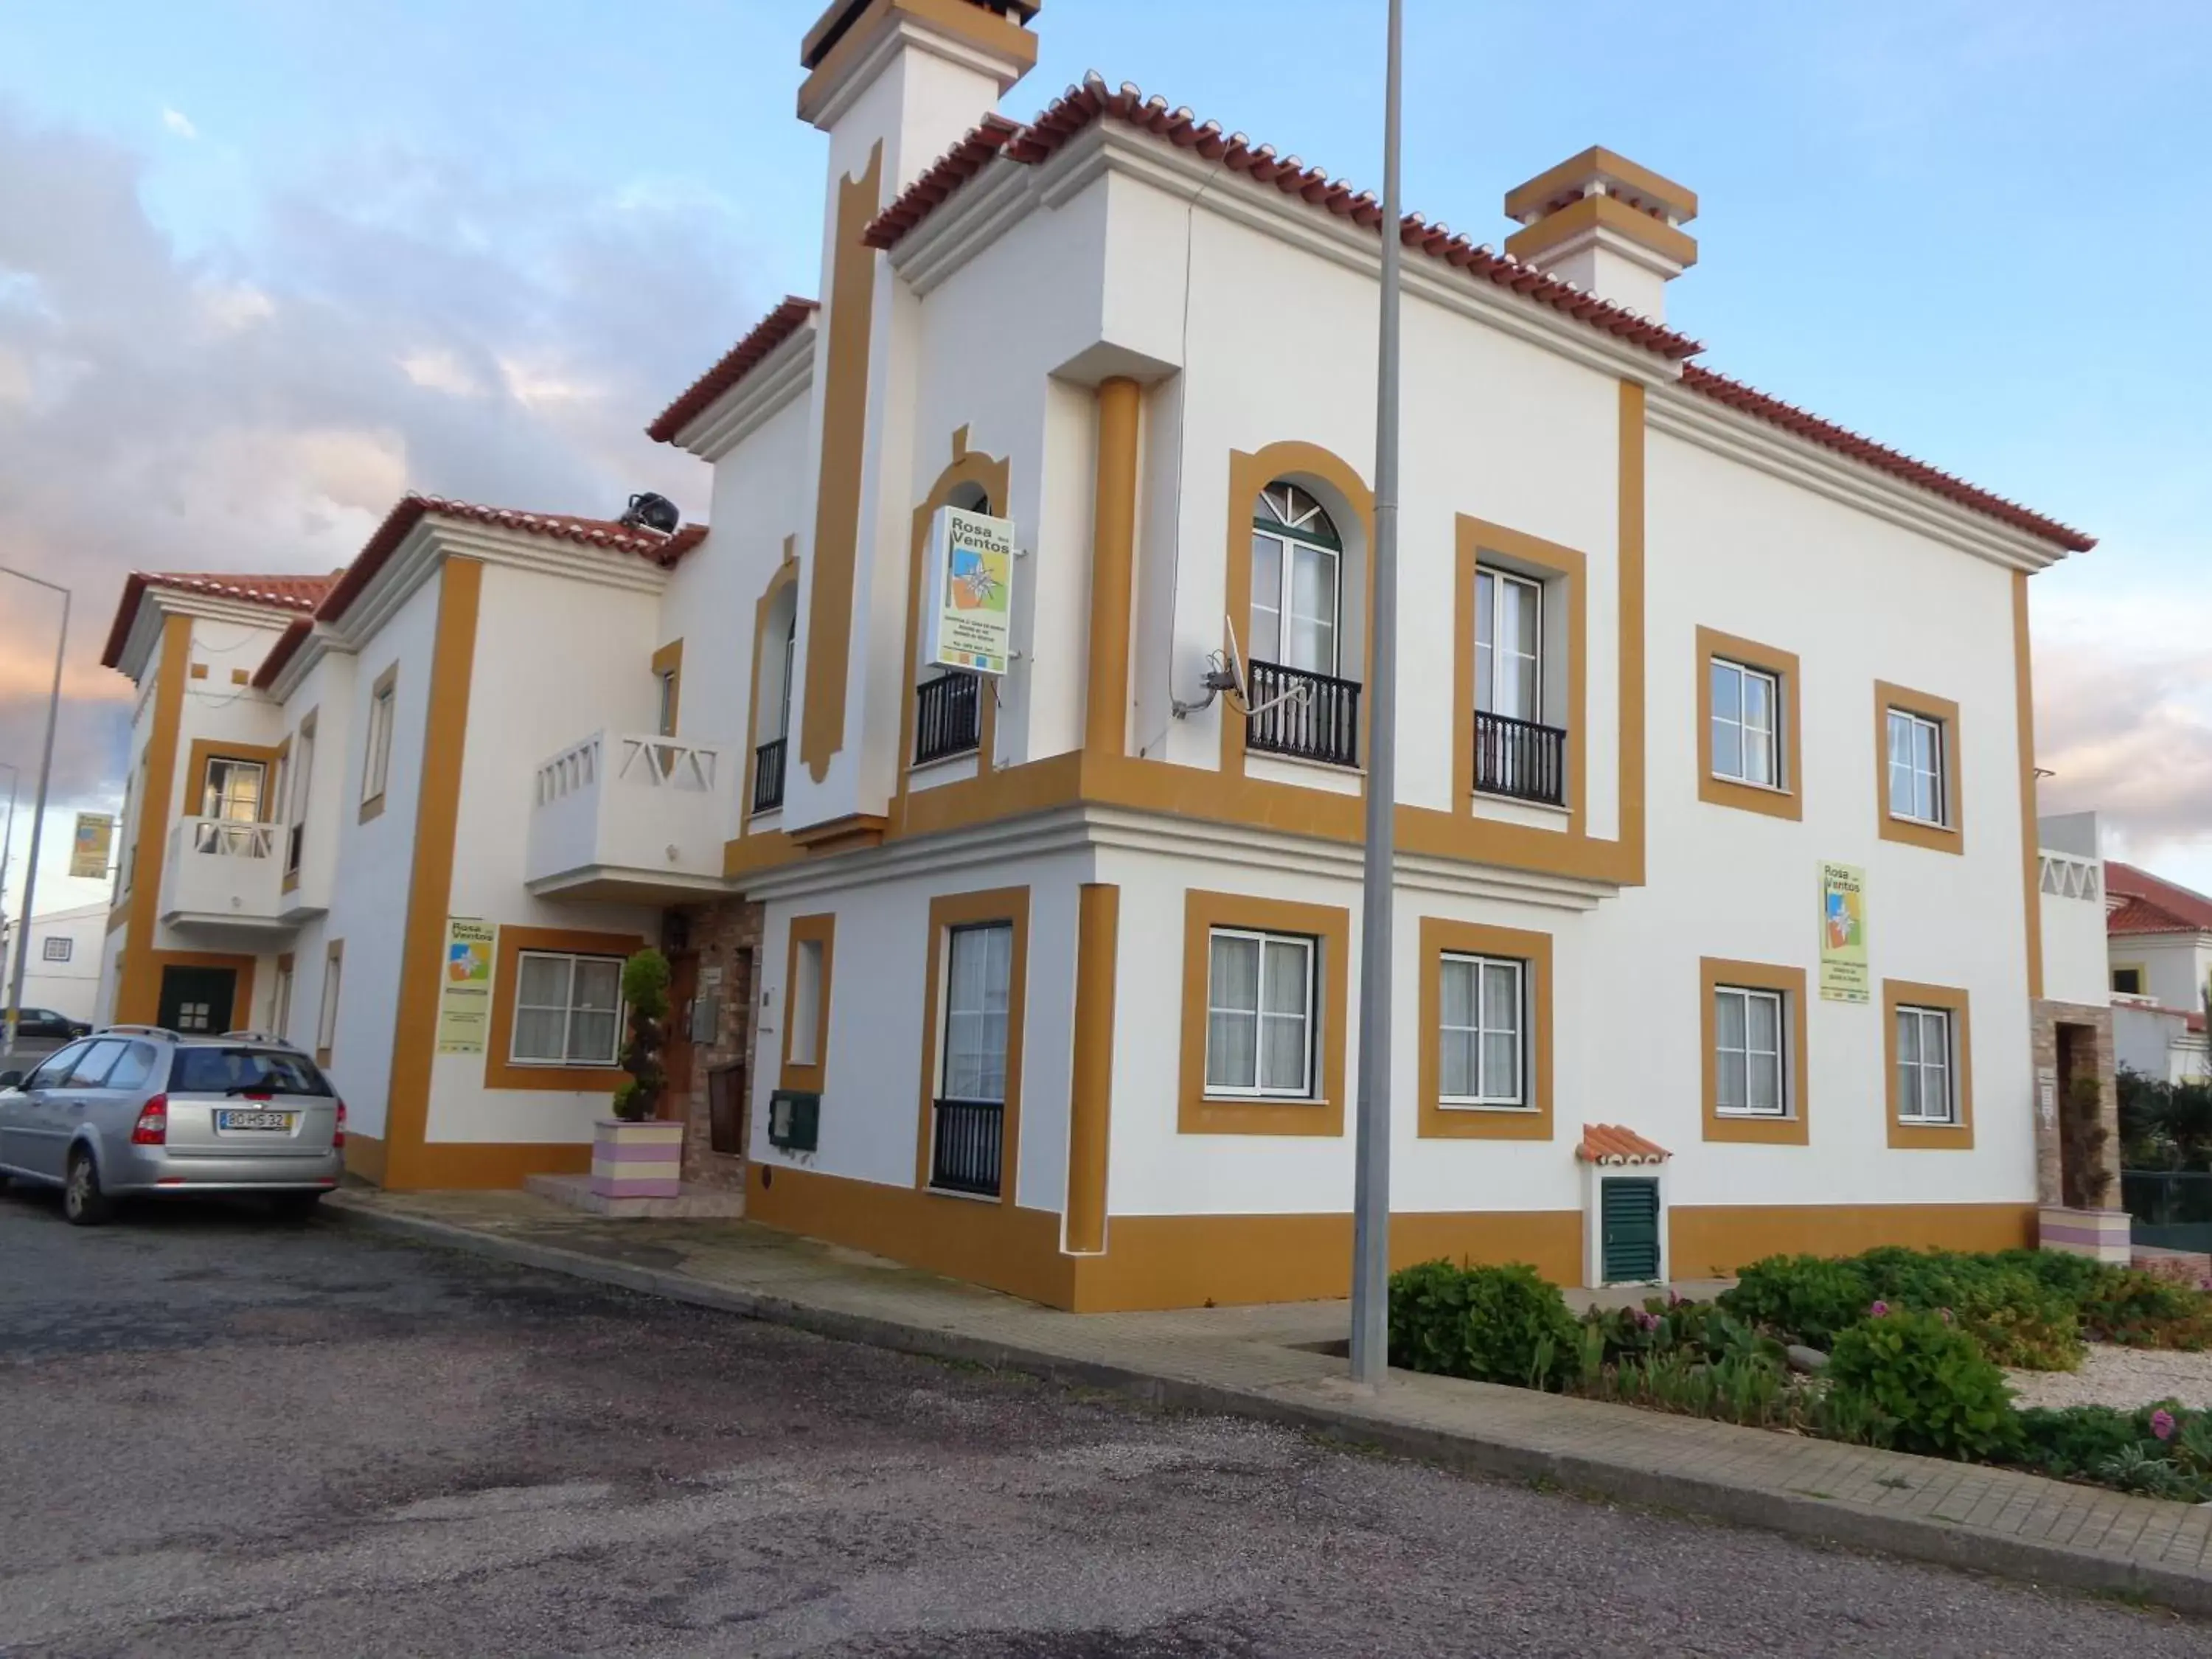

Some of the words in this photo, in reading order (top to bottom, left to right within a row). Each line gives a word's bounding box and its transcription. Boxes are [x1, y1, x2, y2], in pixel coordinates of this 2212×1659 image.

[952, 517, 992, 537] Rosa
[953, 529, 1009, 554] Ventos
[1825, 865, 1848, 879] Rosa
[453, 922, 481, 932] Rosa
